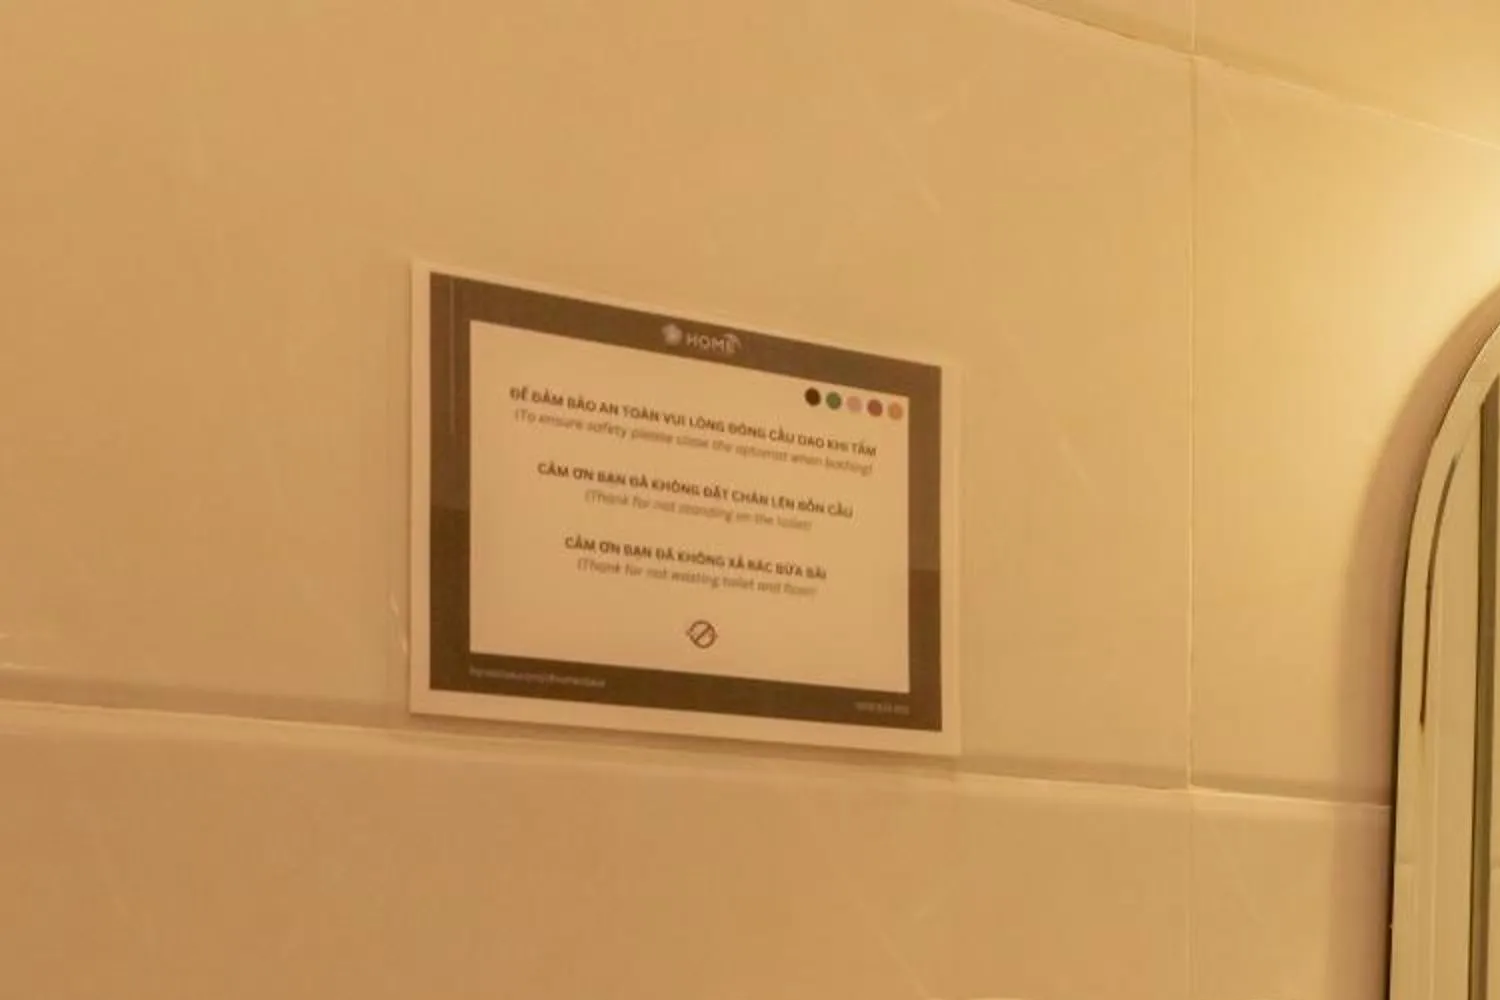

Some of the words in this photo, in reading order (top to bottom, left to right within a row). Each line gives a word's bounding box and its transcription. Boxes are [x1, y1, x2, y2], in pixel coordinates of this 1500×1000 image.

[685, 331, 736, 355] HOME
[538, 414, 584, 430] ensure
[586, 421, 627, 438] safety
[711, 439, 732, 453] the
[567, 394, 597, 412] BẢO
[599, 400, 619, 416] AN
[622, 404, 659, 422] TOÀN
[662, 412, 686, 427] VUI
[689, 415, 725, 433] LÒNG
[728, 421, 767, 440] ĐÓNG
[769, 423, 795, 444] CẦU
[798, 434, 825, 449] DAO
[827, 438, 849, 453] KHI
[537, 460, 569, 478] CẢM
[572, 467, 593, 481] ƠN
[651, 479, 700, 497] KHÔNG
[731, 490, 768, 506] CHÂN
[771, 495, 795, 510] LÊN
[827, 501, 854, 519] CẦU
[564, 533, 596, 551] CẢM
[599, 540, 621, 555] ƠN
[677, 550, 726, 567] KHÔNG
[728, 553, 745, 569] XẢ
